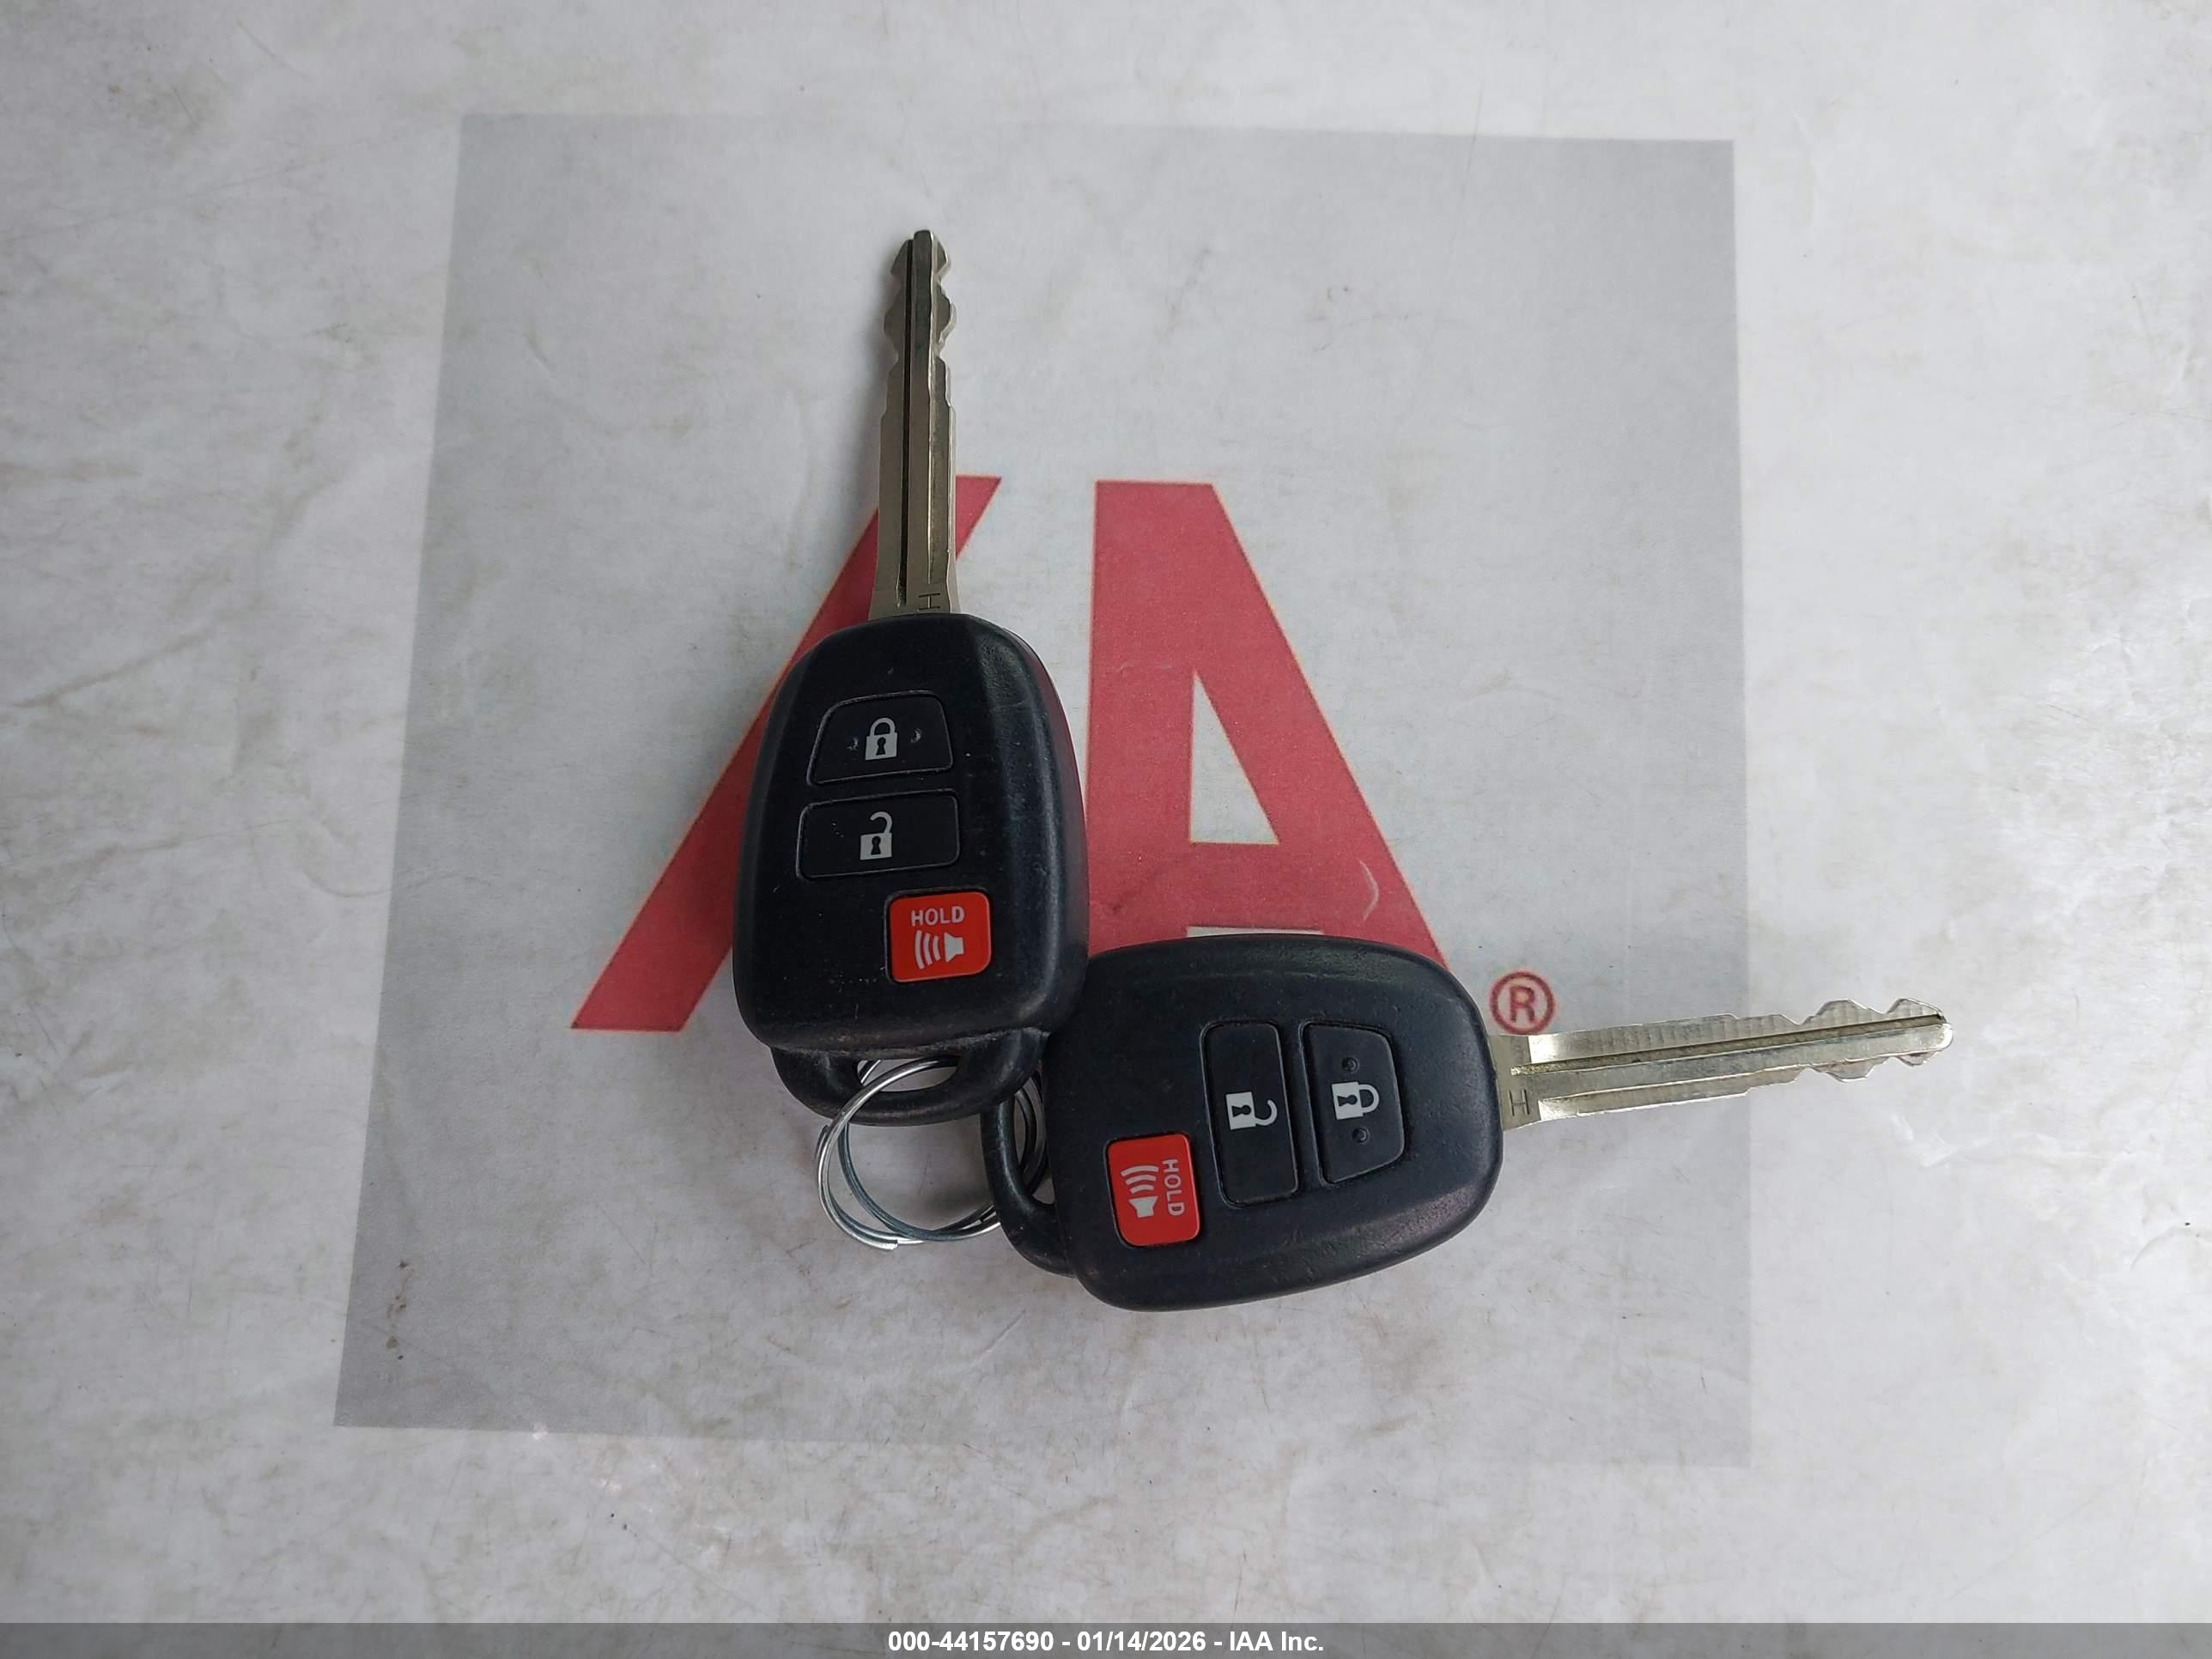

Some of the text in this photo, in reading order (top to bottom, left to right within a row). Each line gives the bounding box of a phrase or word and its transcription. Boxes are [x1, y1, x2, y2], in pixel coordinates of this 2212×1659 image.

[911, 906, 965, 927] HOLD
[1509, 1089, 1530, 1116] H
[1162, 1158, 1185, 1217] HOLD
